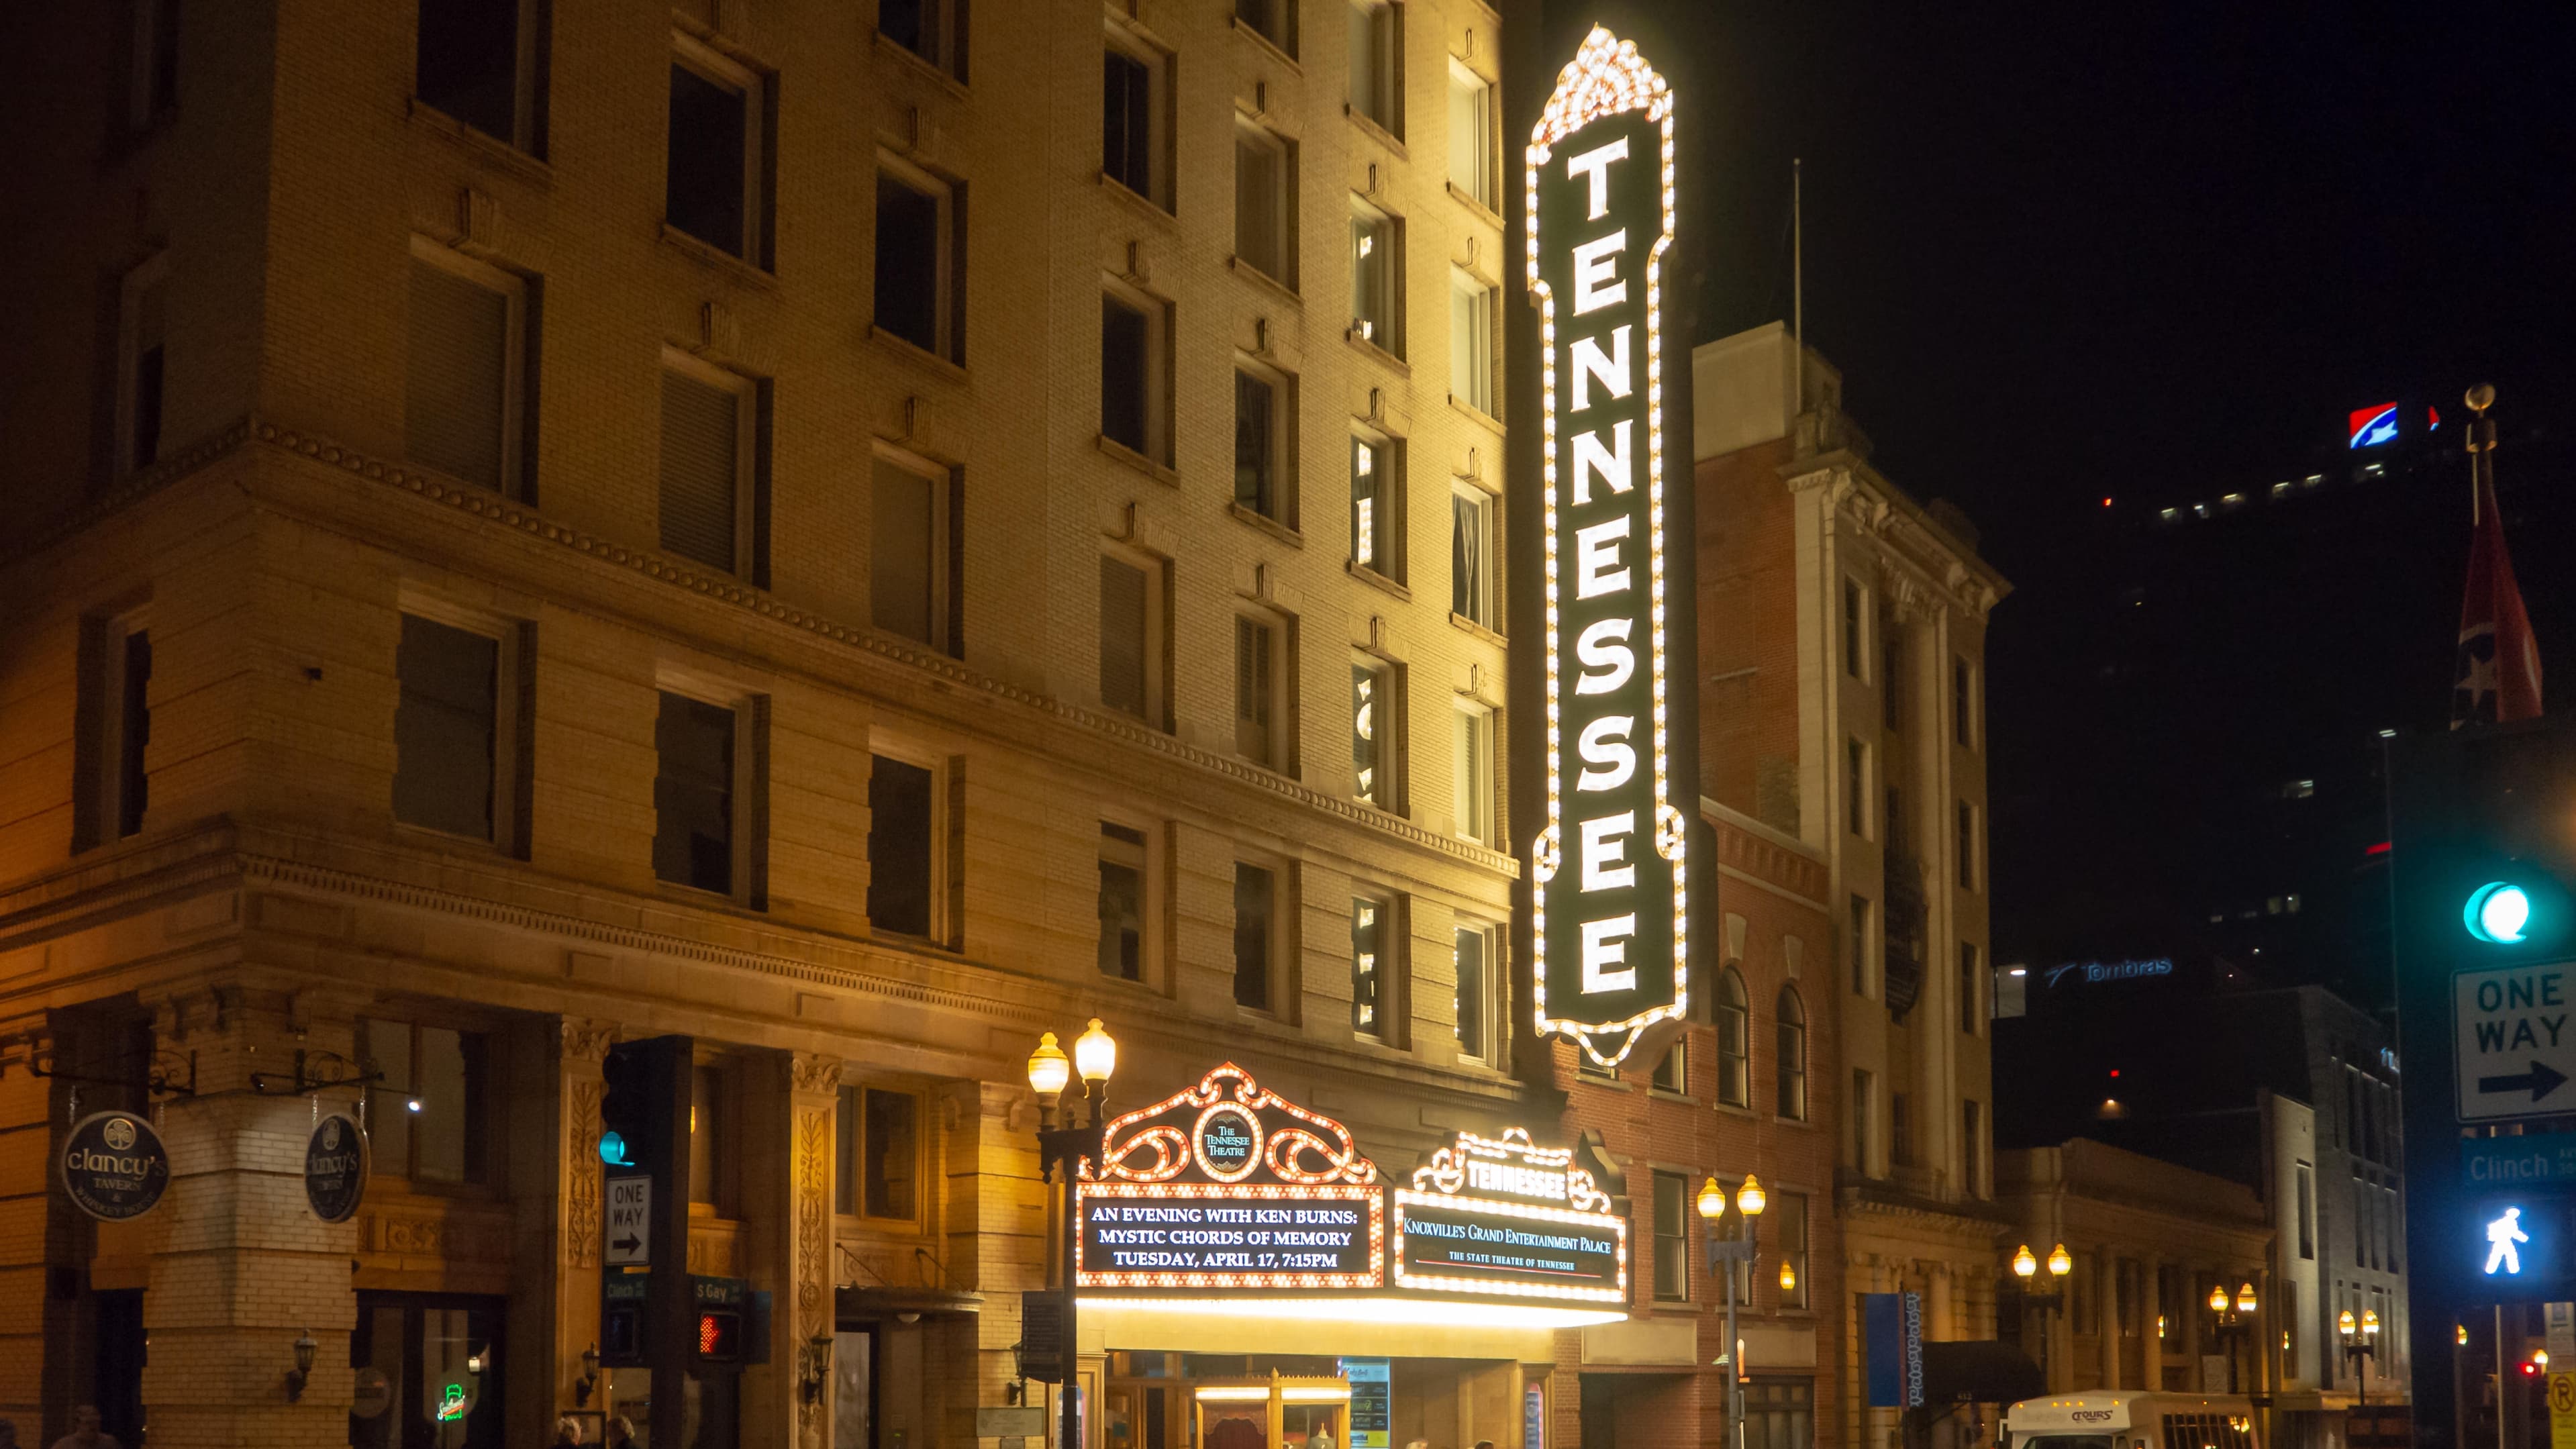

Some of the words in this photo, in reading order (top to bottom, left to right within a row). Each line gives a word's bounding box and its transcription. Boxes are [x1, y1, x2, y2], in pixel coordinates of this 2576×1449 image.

[1567, 134, 1637, 995] TENNESSEE
[2079, 958, 2173, 982] Tombras
[2477, 973, 2564, 1012] ONE
[2475, 1014, 2567, 1053] WAY
[1205, 1134, 1250, 1146] TENNESSEE
[1218, 1126, 1235, 1136] THE
[1207, 1145, 1245, 1156] THEATRE
[68, 1148, 167, 1181] clancy's
[2470, 1153, 2548, 1181] Clinch
[93, 1177, 143, 1192] TAVERN
[1467, 1160, 1565, 1199] TENNESSEE
[615, 1185, 643, 1203] ONE
[613, 1207, 644, 1226] WAY
[1091, 1208, 1118, 1221] AN
[1123, 1208, 1201, 1222] EVENING
[1205, 1209, 1252, 1223] WITH
[1255, 1209, 1292, 1223] KEN
[1295, 1209, 1358, 1224] BURNS:
[1099, 1230, 1166, 1244] MYSTIC
[1170, 1230, 1244, 1245] CHORDS
[1248, 1232, 1270, 1245] OF
[1274, 1232, 1352, 1246] MEMORY
[1403, 1218, 1465, 1239] KNOXVILLE'S
[1468, 1224, 1503, 1242] GRAND
[1505, 1229, 1579, 1250] ENTERTAINMENT
[1580, 1237, 1611, 1254] PALACE
[1113, 1251, 1200, 1268] TUESDAY,
[1204, 1252, 1254, 1267] APRIL
[1257, 1253, 1279, 1269] 17,
[1281, 1254, 1337, 1267] 7:15PM
[1450, 1251, 1464, 1260] THE
[1467, 1252, 1490, 1263] STATE
[1492, 1255, 1524, 1266] THEATRE
[1526, 1258, 1535, 1267] OF
[1537, 1260, 1575, 1270] TENNESSEE
[607, 1283, 634, 1298] Clinch
[698, 1285, 703, 1298] S
[706, 1283, 726, 1303] Gay
